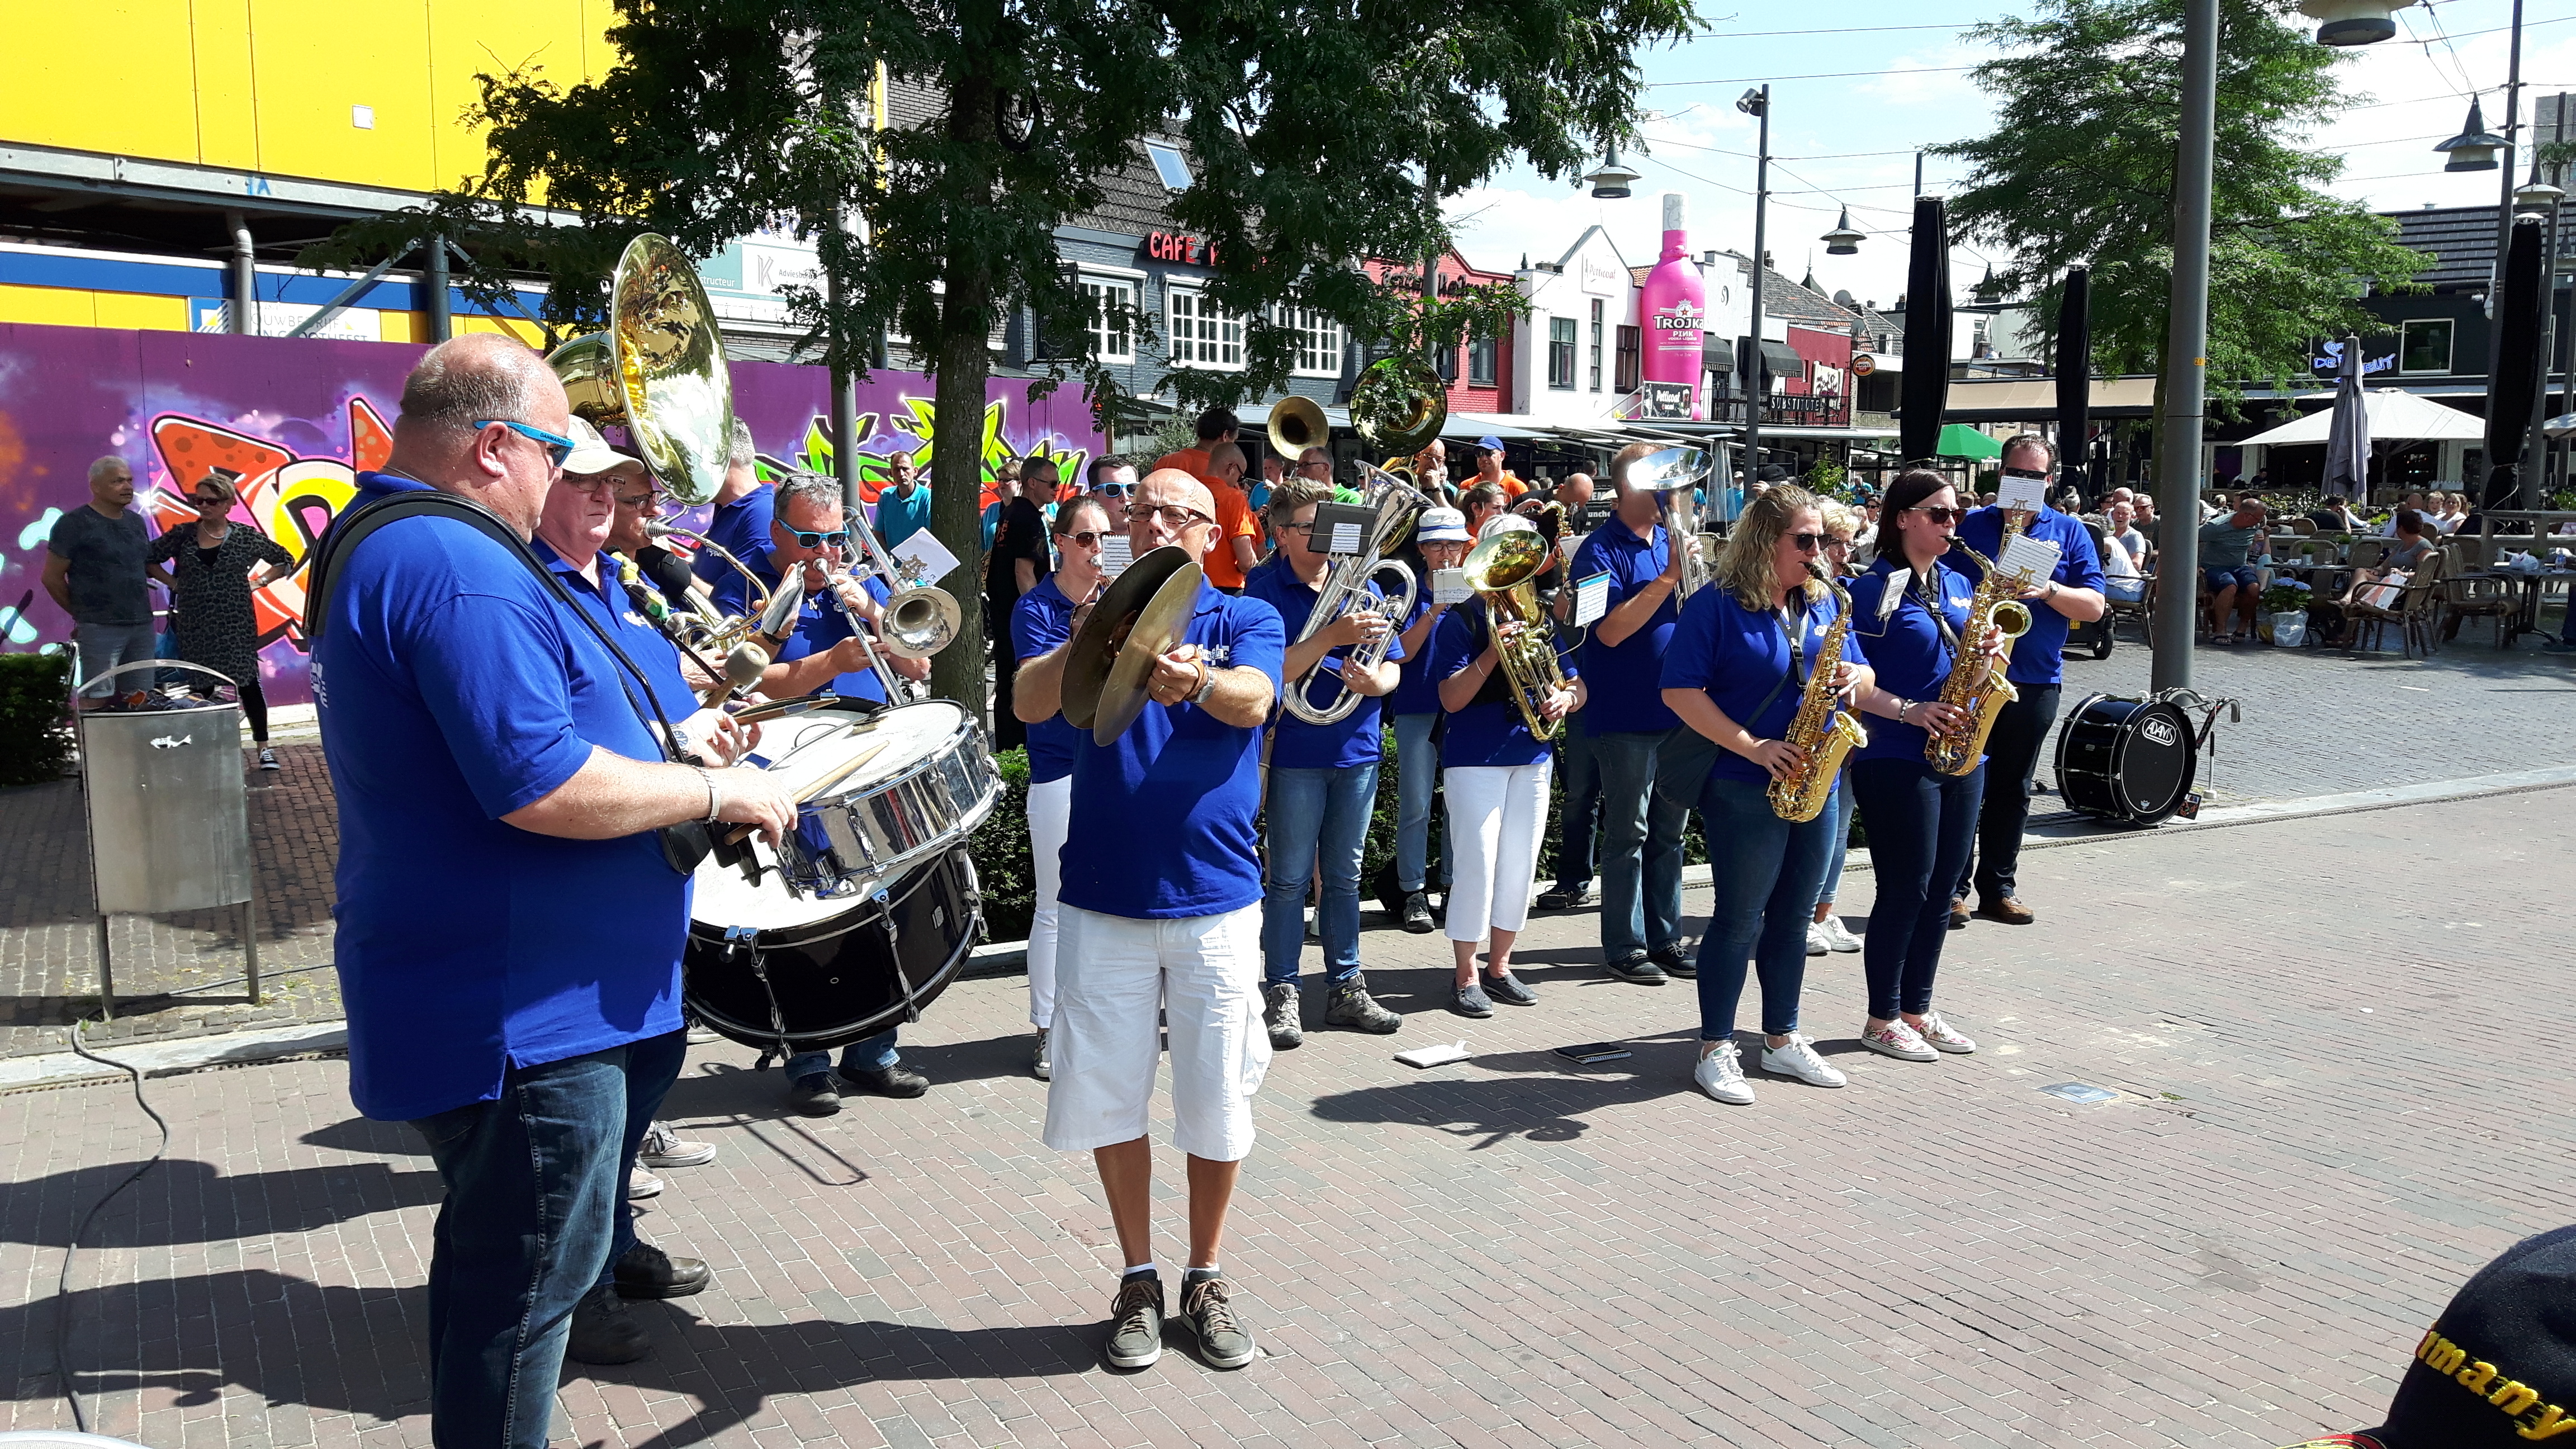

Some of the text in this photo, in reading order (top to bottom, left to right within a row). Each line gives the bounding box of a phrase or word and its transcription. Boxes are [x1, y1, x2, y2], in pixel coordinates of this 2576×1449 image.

[1772, 368, 1798, 377] SUBSTITUTE
[1771, 396, 1820, 411] SUBSTITUTE
[2145, 721, 2174, 743] ADAMS
